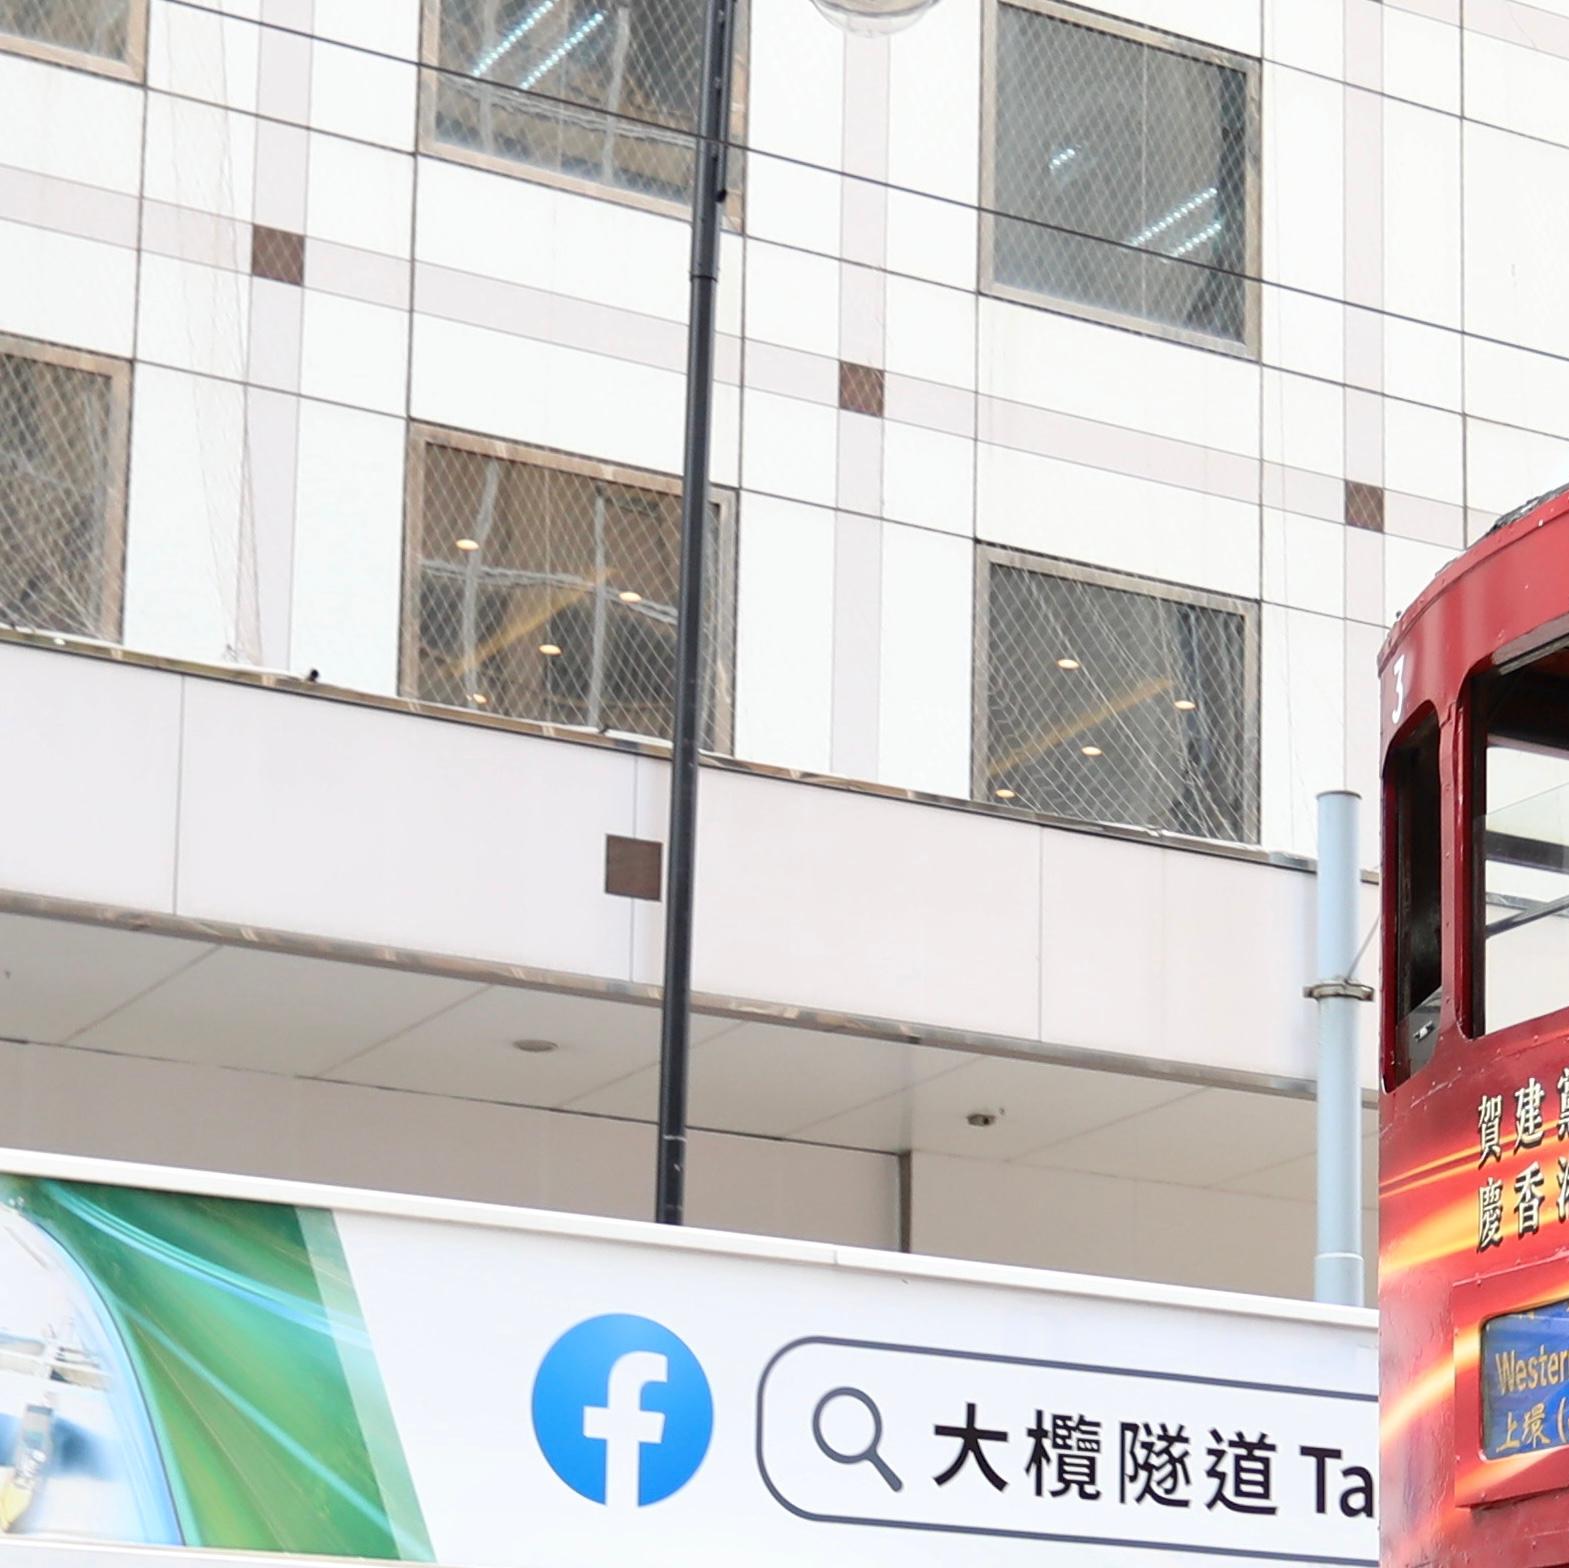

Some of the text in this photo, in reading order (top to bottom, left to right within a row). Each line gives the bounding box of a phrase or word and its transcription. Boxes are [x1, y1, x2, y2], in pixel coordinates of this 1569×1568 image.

[932, 1402, 1279, 1517] 大欖隧道
[1299, 1444, 1375, 1518] Ta
